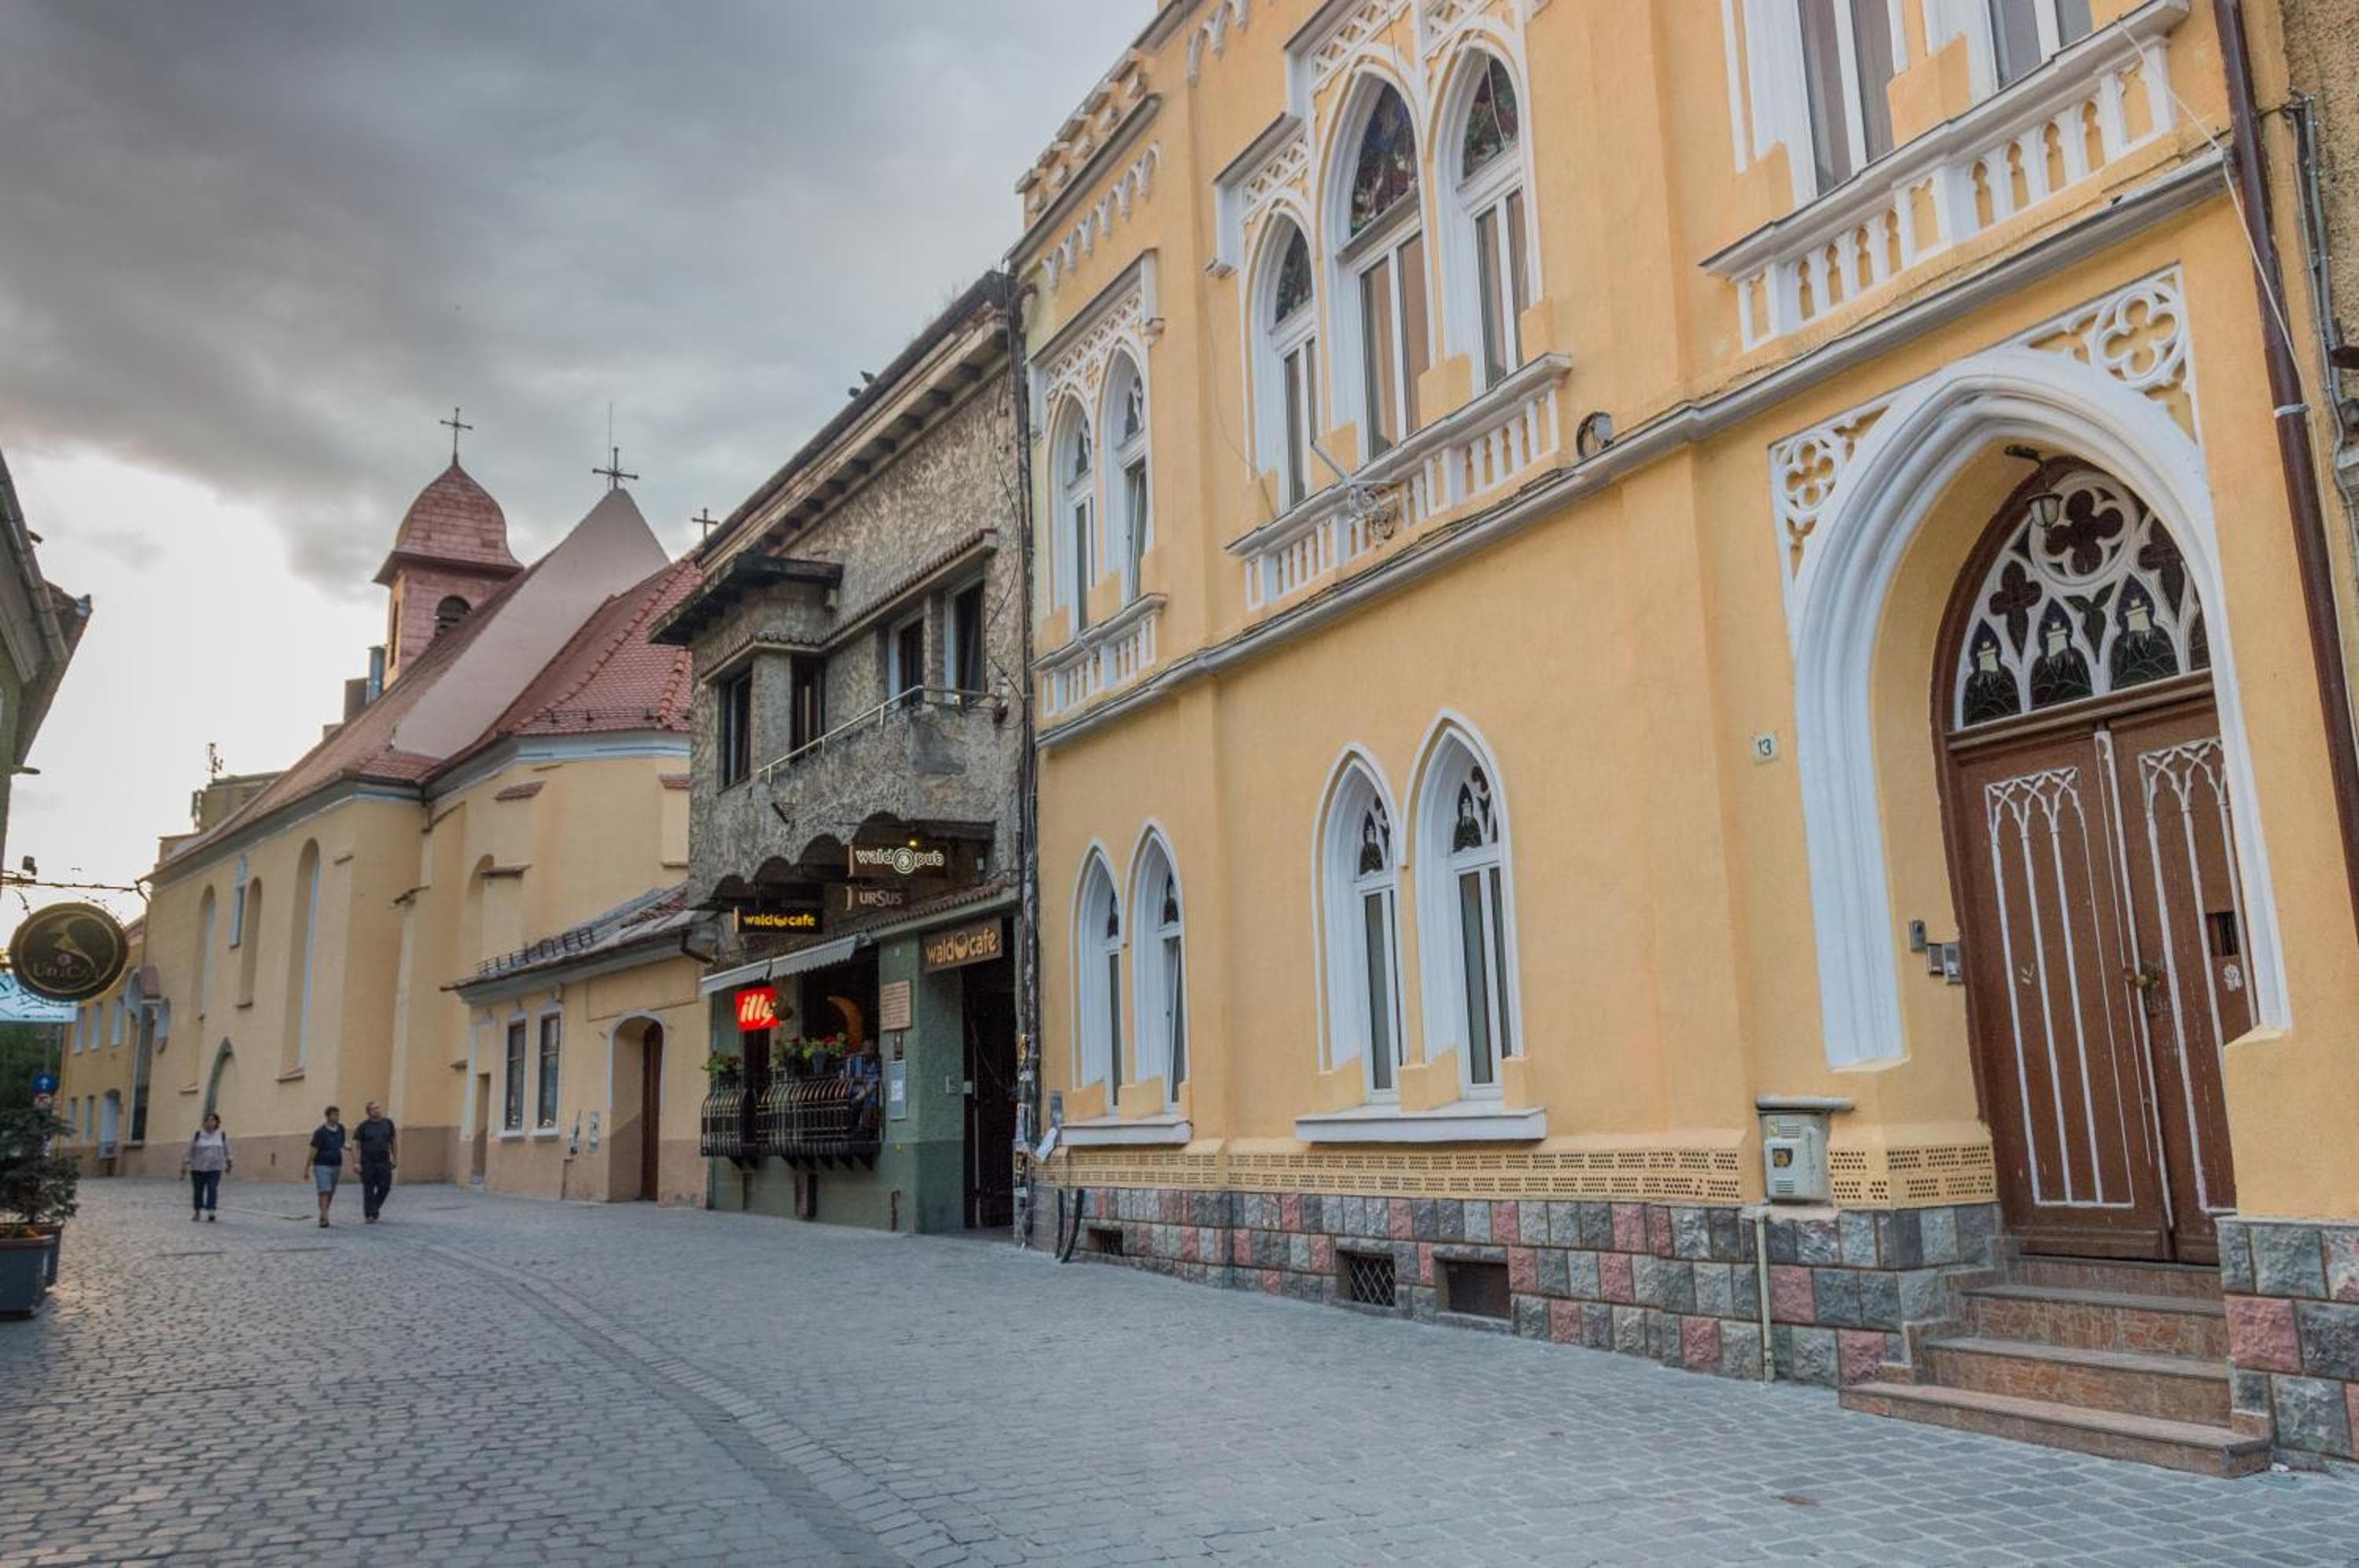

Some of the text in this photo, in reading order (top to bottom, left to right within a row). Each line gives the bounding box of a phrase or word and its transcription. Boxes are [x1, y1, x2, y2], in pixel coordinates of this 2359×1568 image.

[1757, 738, 1772, 756] 13
[855, 848, 944, 868] wald pub
[859, 890, 903, 907] URSUS
[743, 914, 815, 926] wald cafe
[926, 928, 996, 965] wald cafe
[740, 993, 776, 1026] illy
